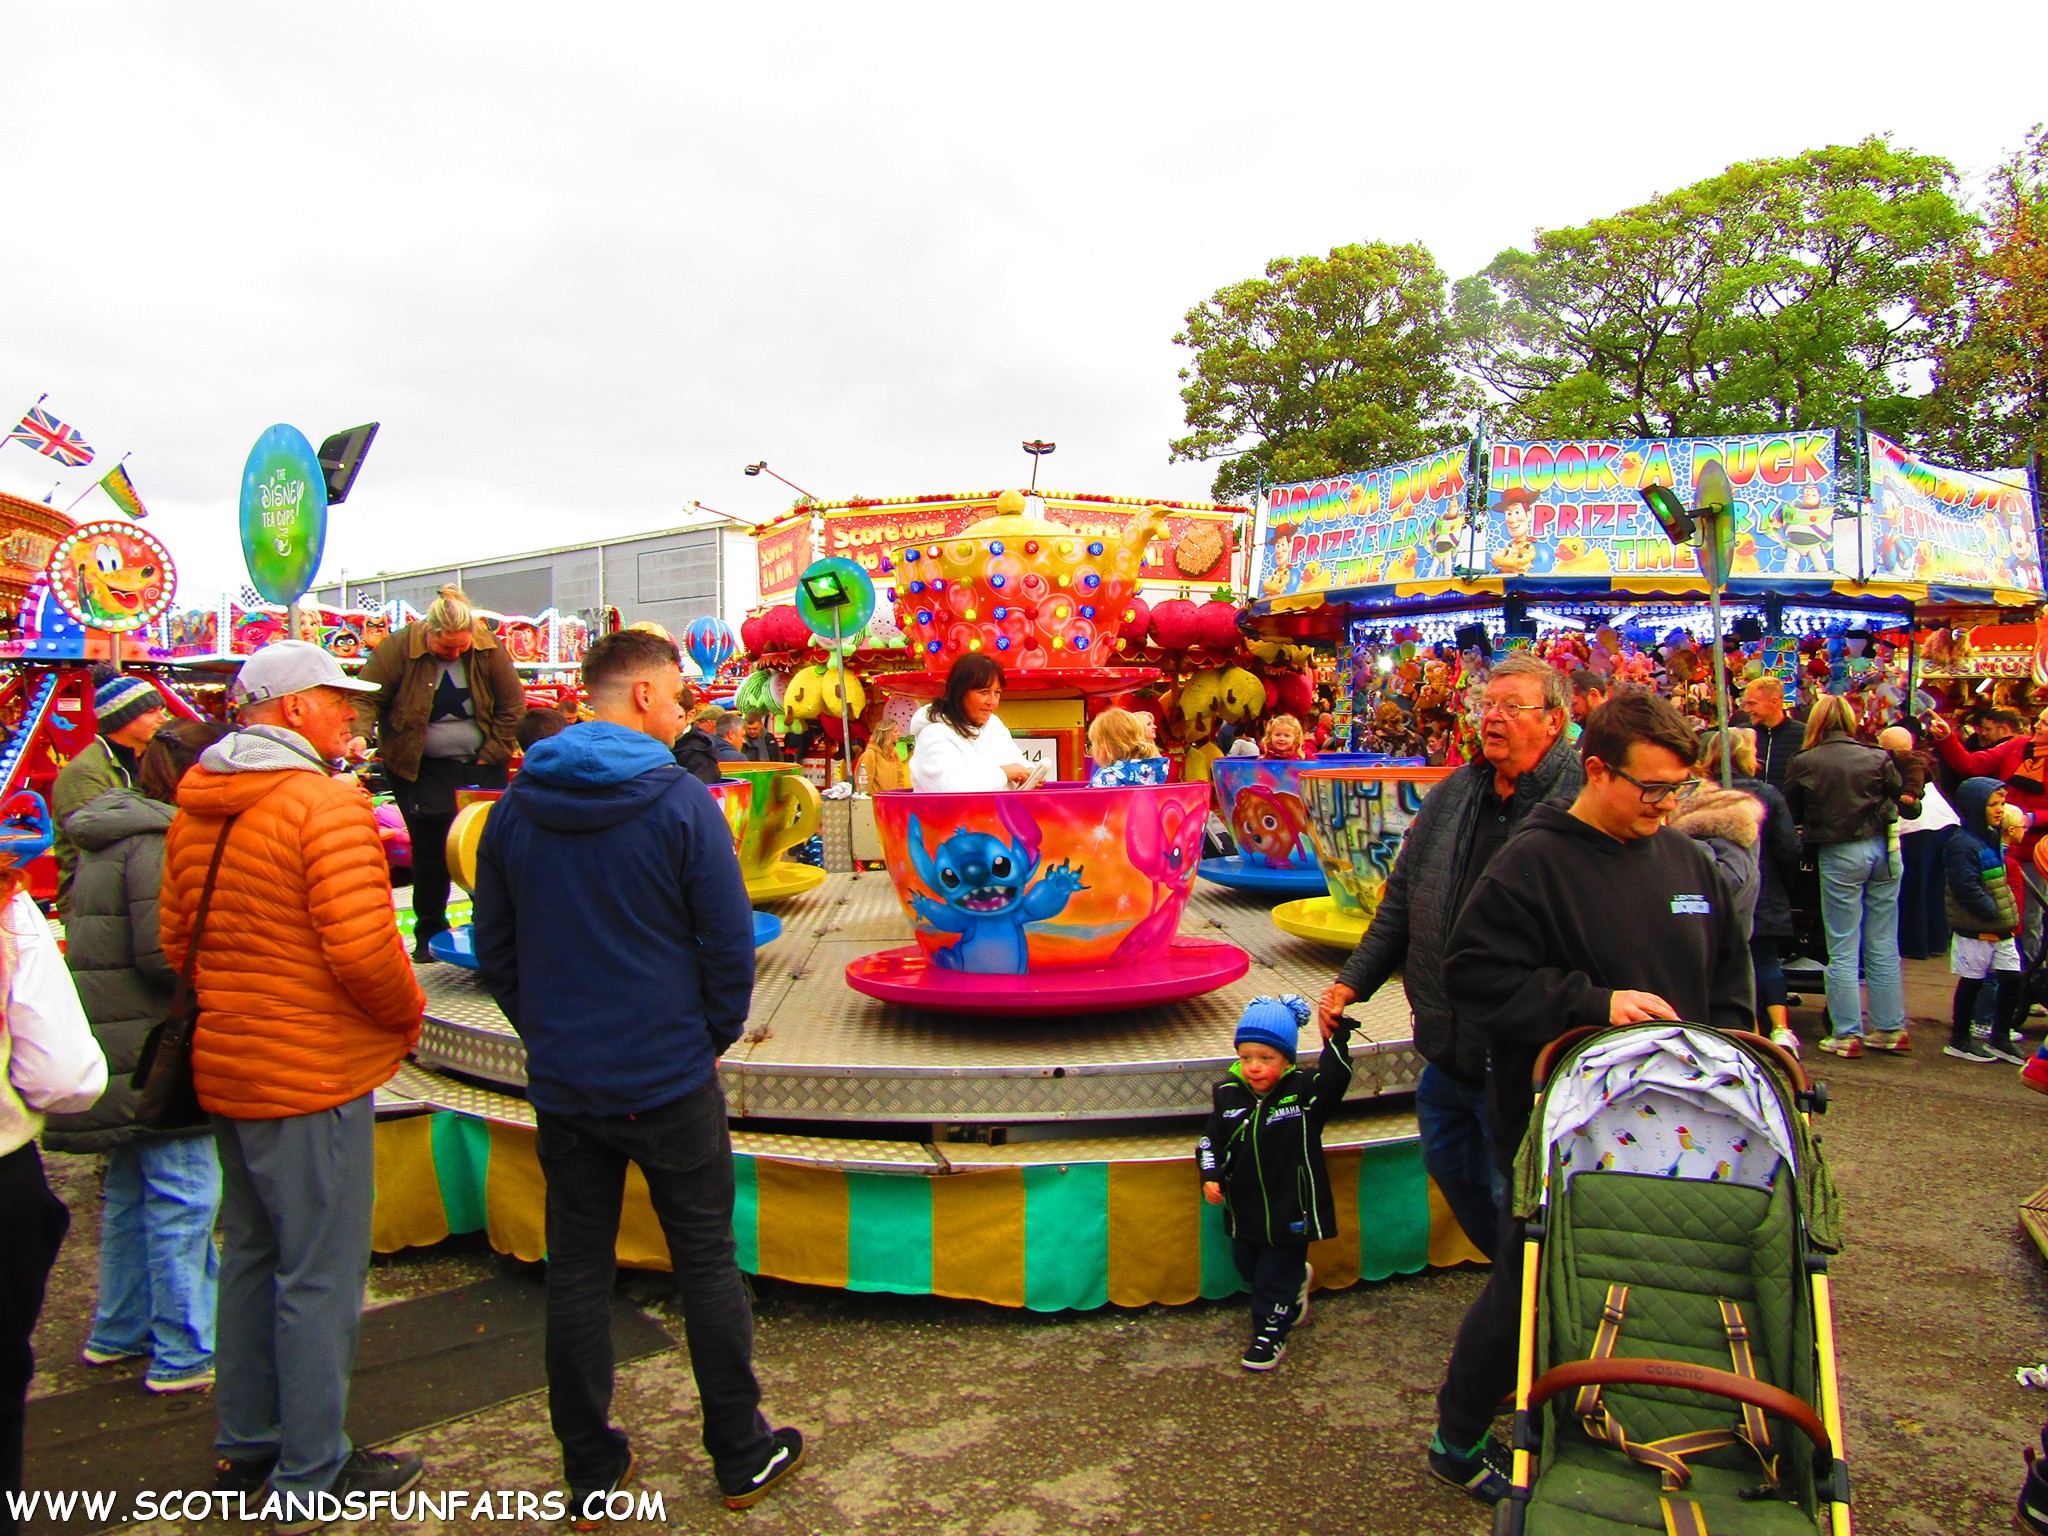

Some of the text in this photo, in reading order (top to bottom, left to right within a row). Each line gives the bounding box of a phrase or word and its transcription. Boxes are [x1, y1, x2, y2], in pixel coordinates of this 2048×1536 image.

[276, 468, 287, 481] THE
[1490, 444, 1622, 492] HOOK
[1639, 443, 1675, 489] A
[1268, 450, 1466, 526] HOOK A DUCK
[262, 508, 295, 528] TEA CUPS
[833, 521, 900, 549] Score
[901, 517, 948, 540] over
[1532, 503, 1641, 537] PRIZE
[1290, 529, 1355, 564] PRIZE
[1361, 513, 1435, 556] EVERY
[1612, 539, 1700, 570] TIME
[857, 551, 879, 571] to
[1335, 554, 1384, 586] TIME
[1645, 1364, 1704, 1380] COSATTO
